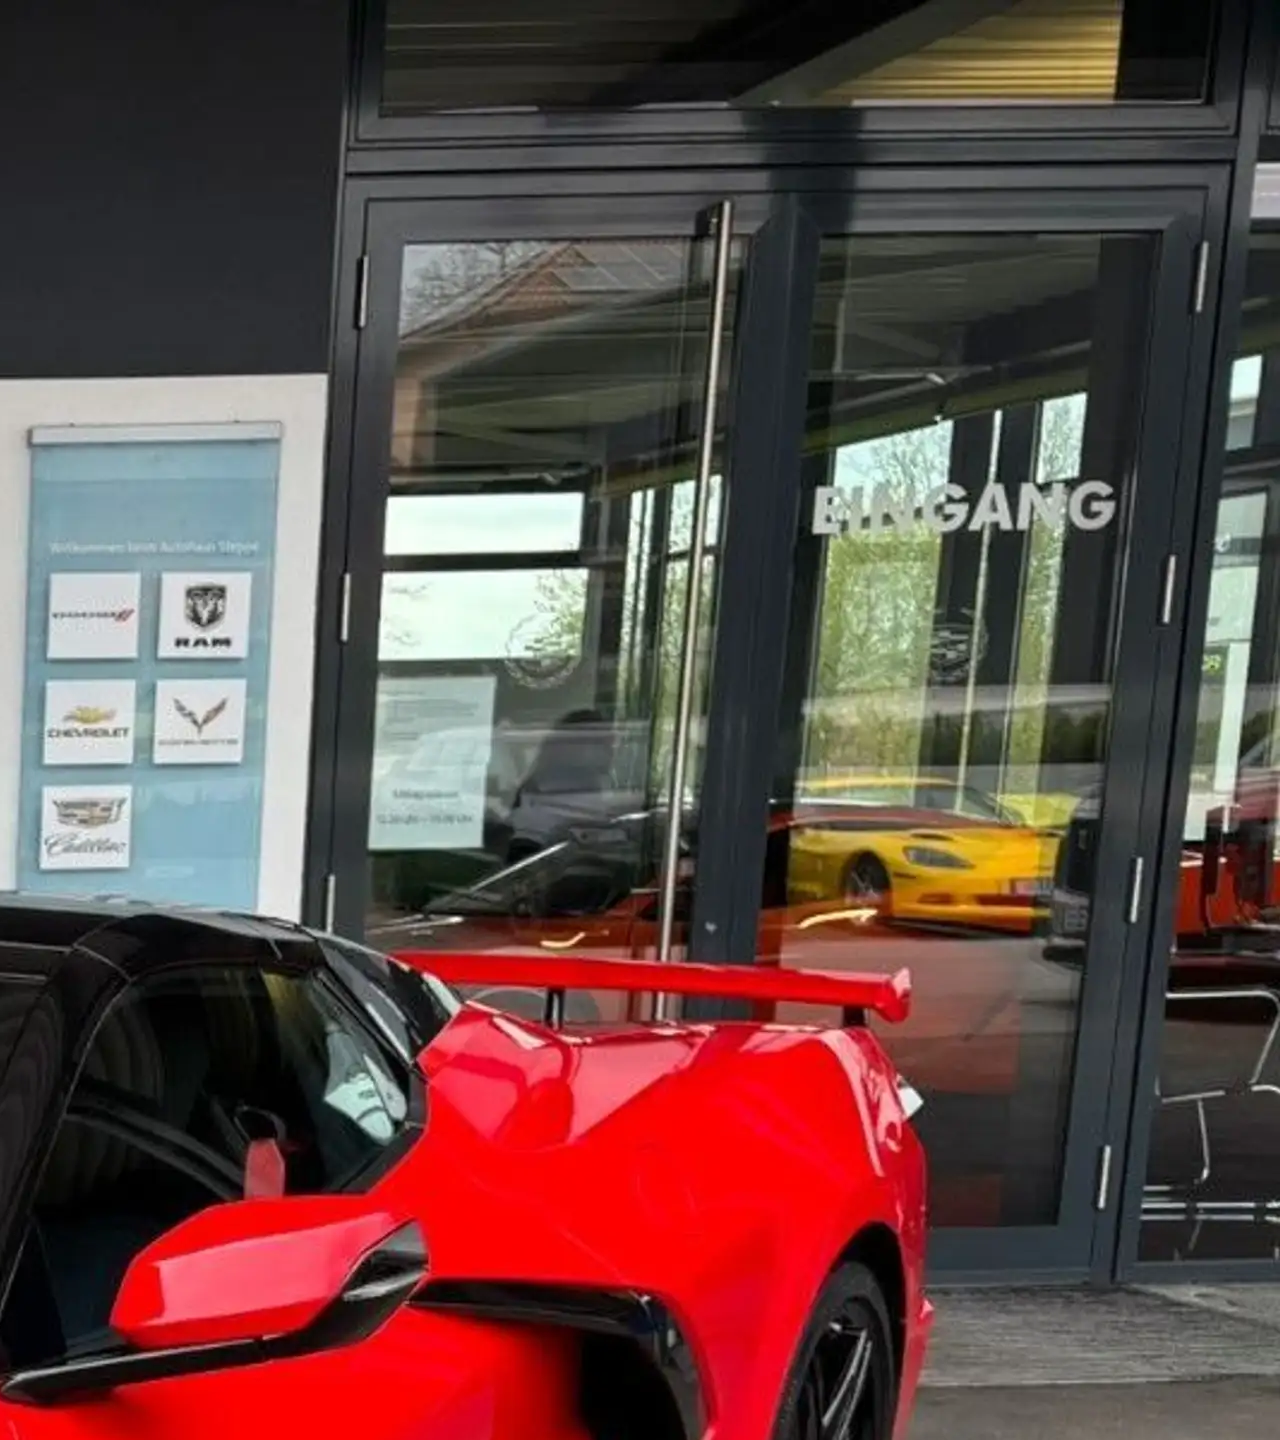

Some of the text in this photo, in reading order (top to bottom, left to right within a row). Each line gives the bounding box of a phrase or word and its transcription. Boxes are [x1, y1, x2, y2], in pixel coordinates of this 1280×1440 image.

[811, 480, 1116, 535] EINGANG
[174, 637, 232, 648] RAM
[47, 727, 130, 739] CHEVROLET
